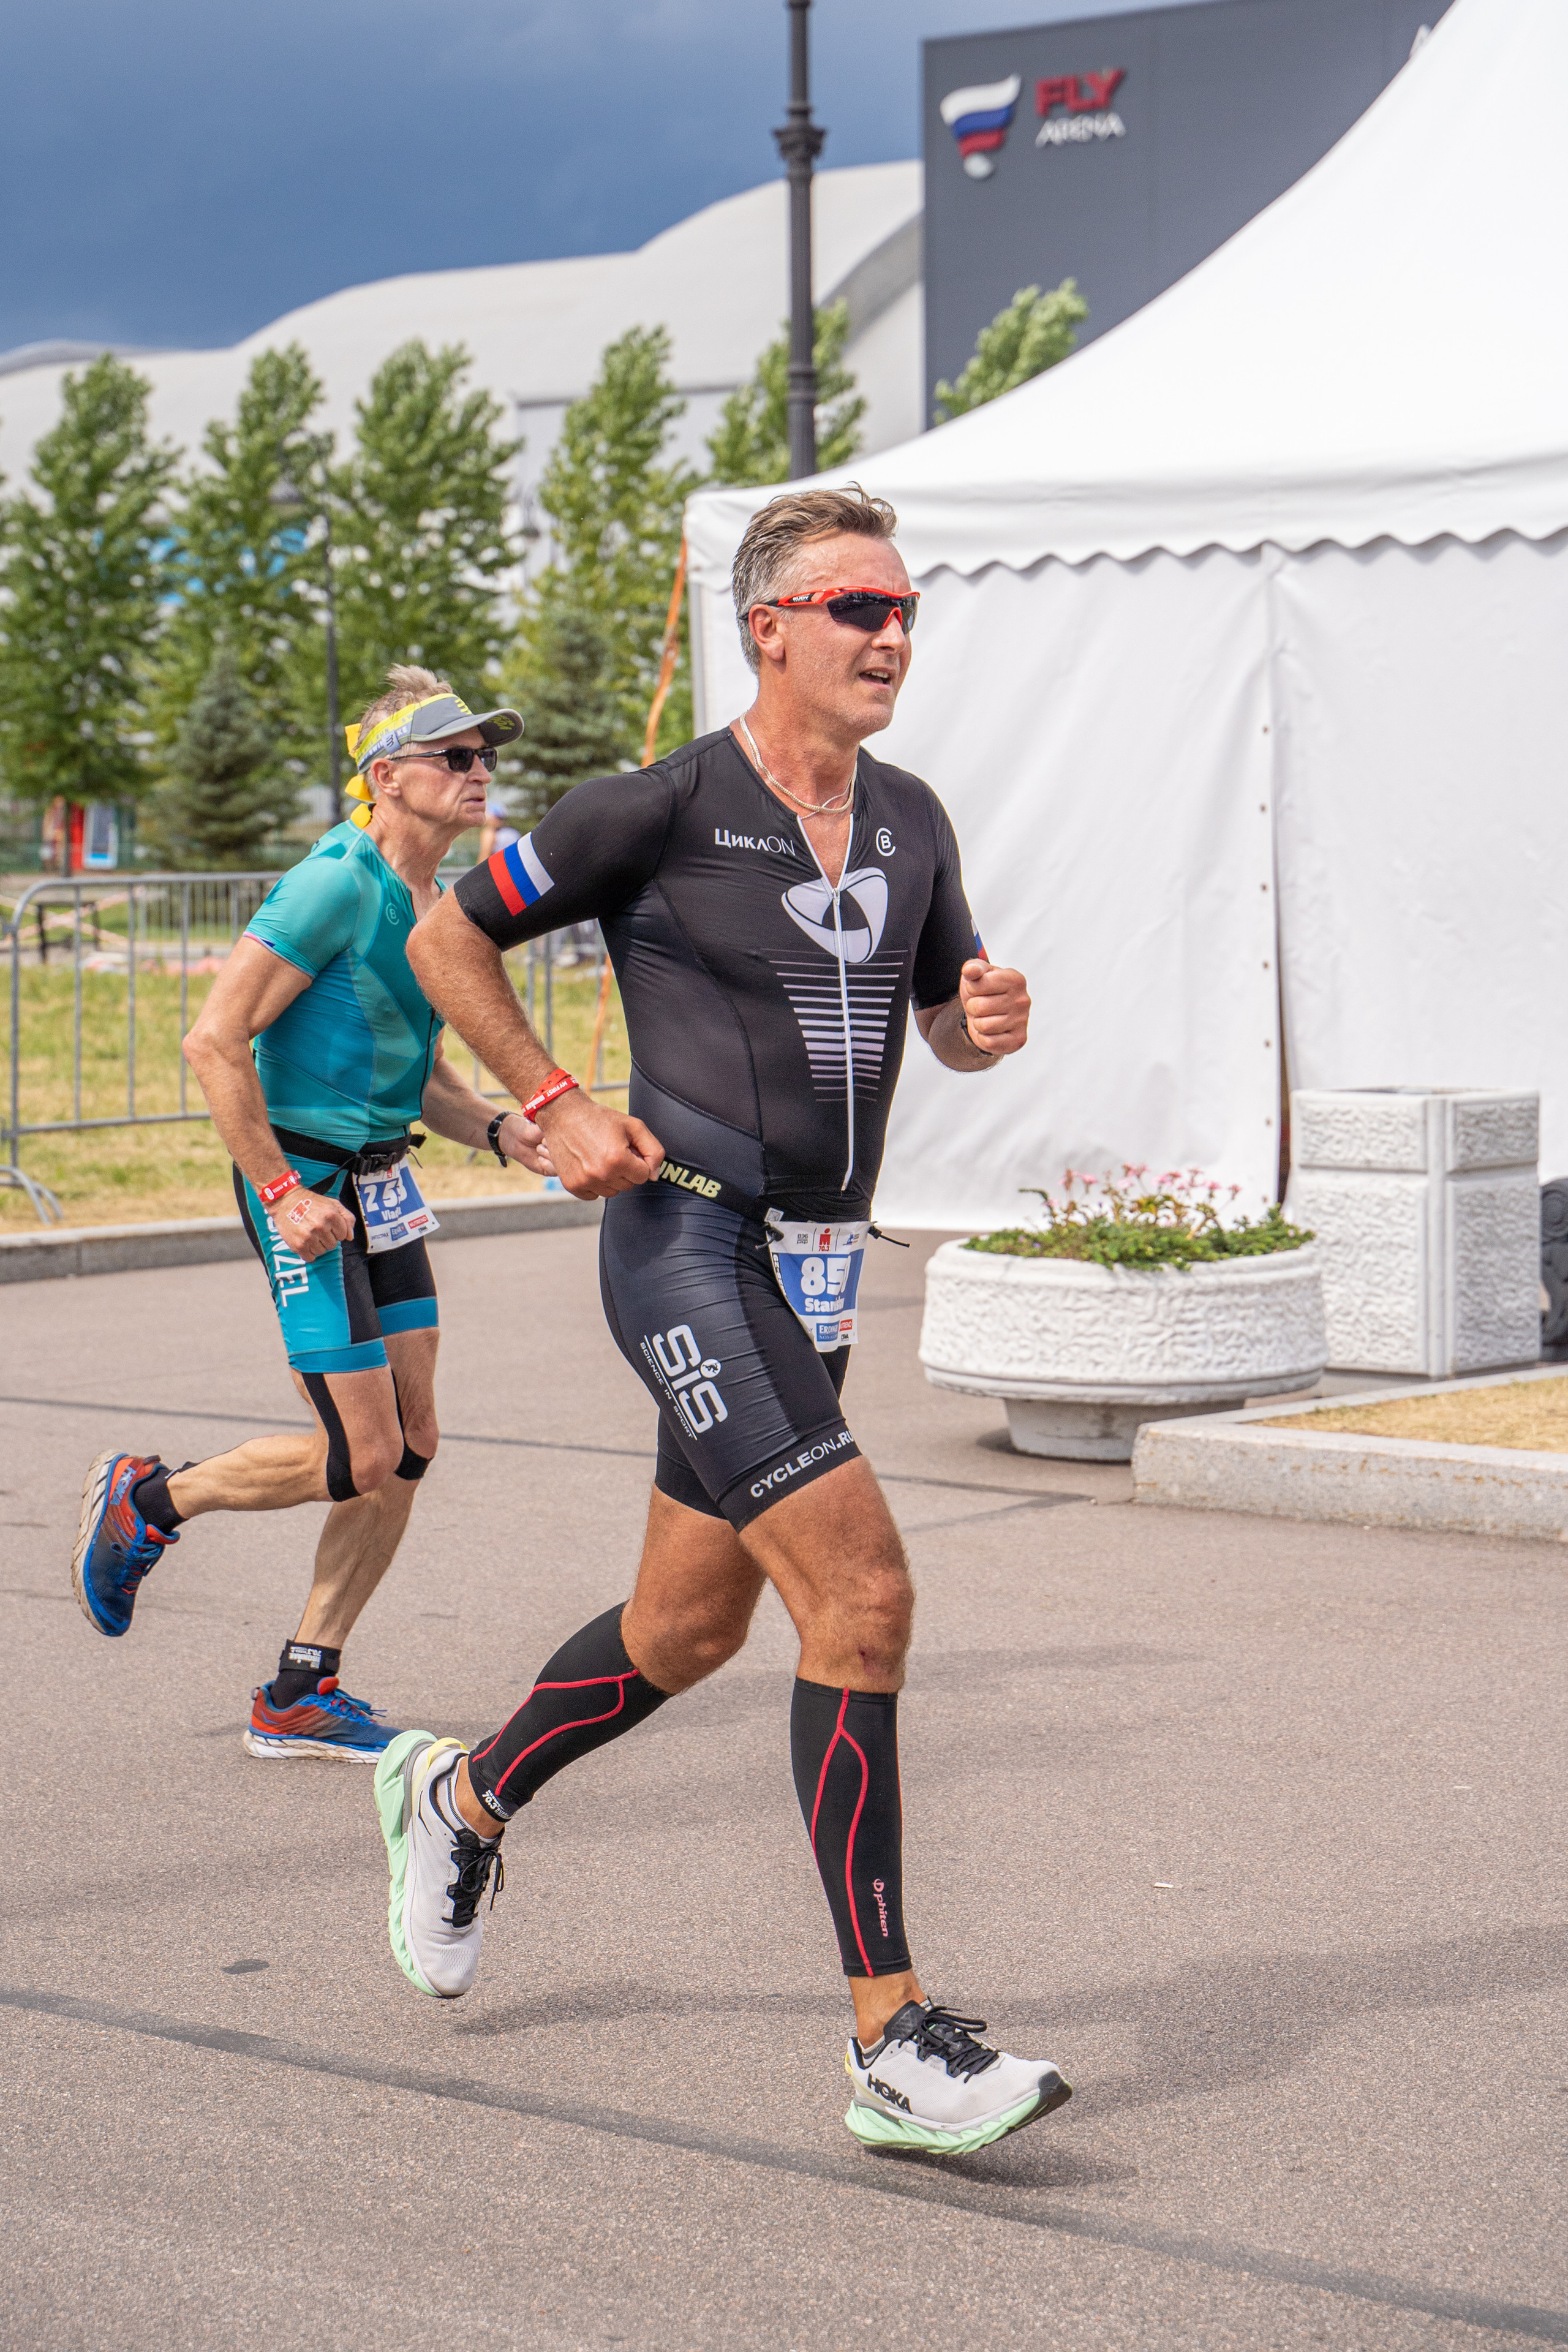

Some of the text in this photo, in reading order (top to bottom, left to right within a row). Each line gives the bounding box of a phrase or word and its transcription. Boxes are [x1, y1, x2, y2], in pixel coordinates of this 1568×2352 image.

[1035, 67, 1126, 116] FLY
[1035, 113, 1126, 148] ARENA
[546, 1084, 560, 1097] FIRST
[640, 1342, 693, 1438] SCIENCE IN SPORT
[482, 1791, 497, 1809] 70.3
[867, 2073, 913, 2114] HOKA
